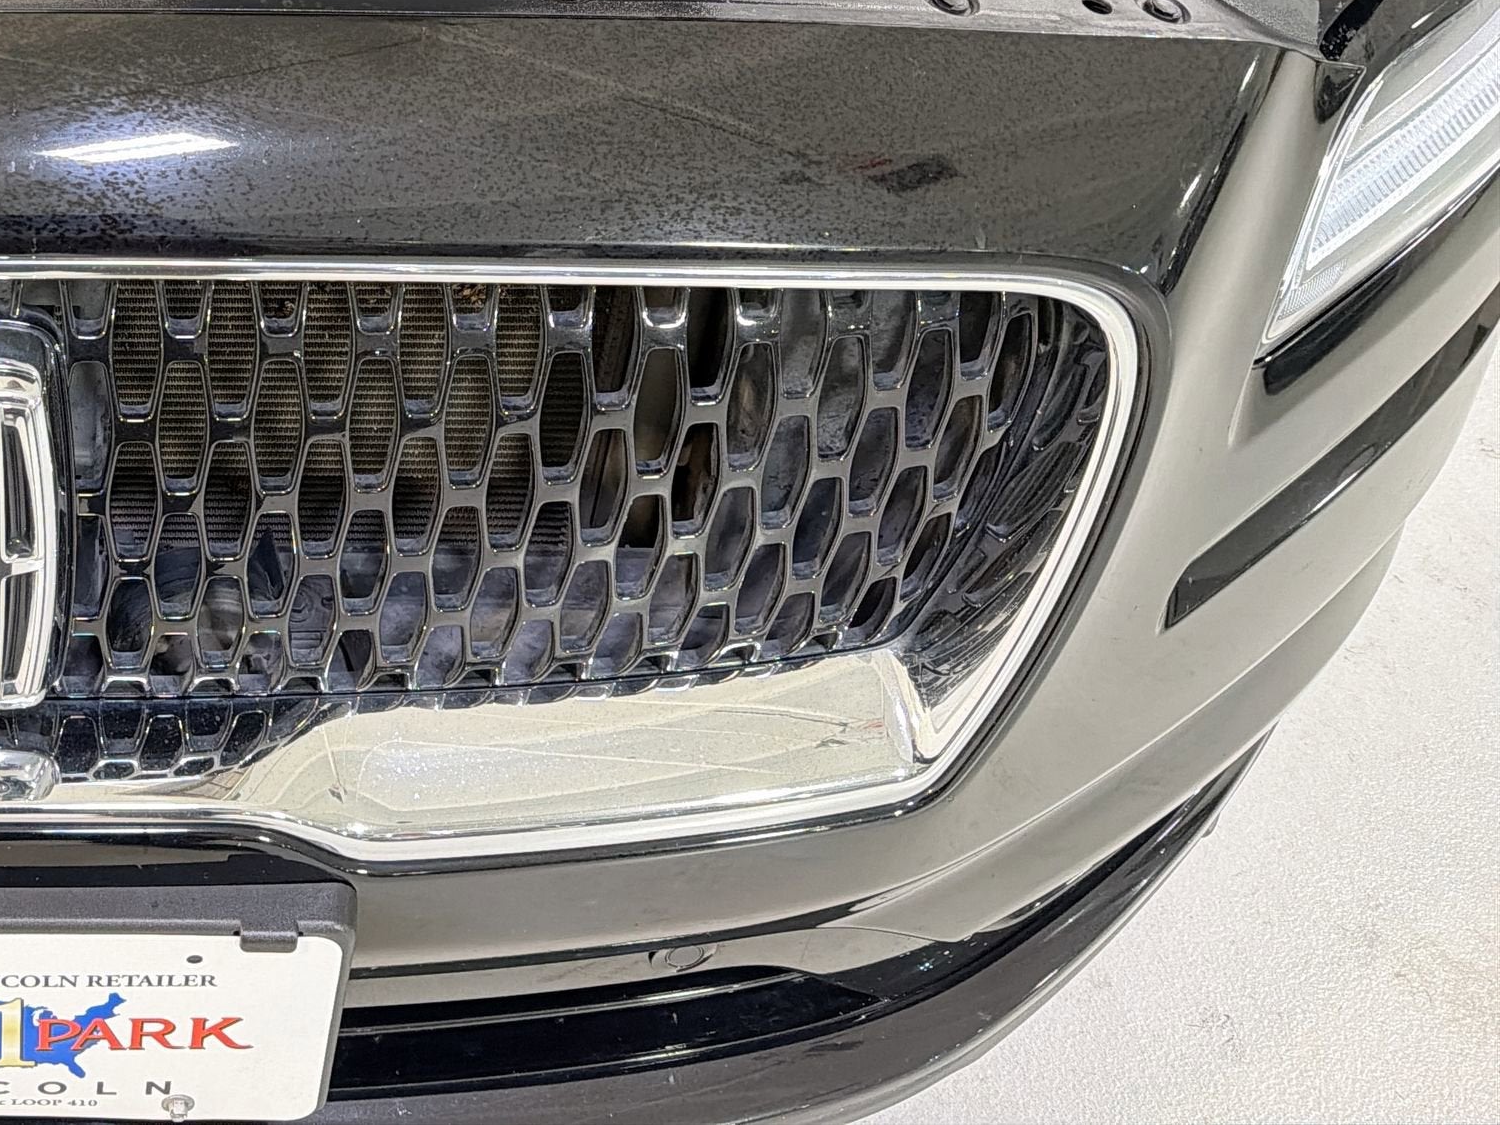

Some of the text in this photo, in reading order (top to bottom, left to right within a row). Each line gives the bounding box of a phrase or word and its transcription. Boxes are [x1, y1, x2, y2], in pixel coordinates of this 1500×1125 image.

[86, 974, 218, 988] RETAILER
[35, 1017, 255, 1051] PARK
[11, 1098, 63, 1107] LOOP
[67, 1098, 98, 1107] 410
